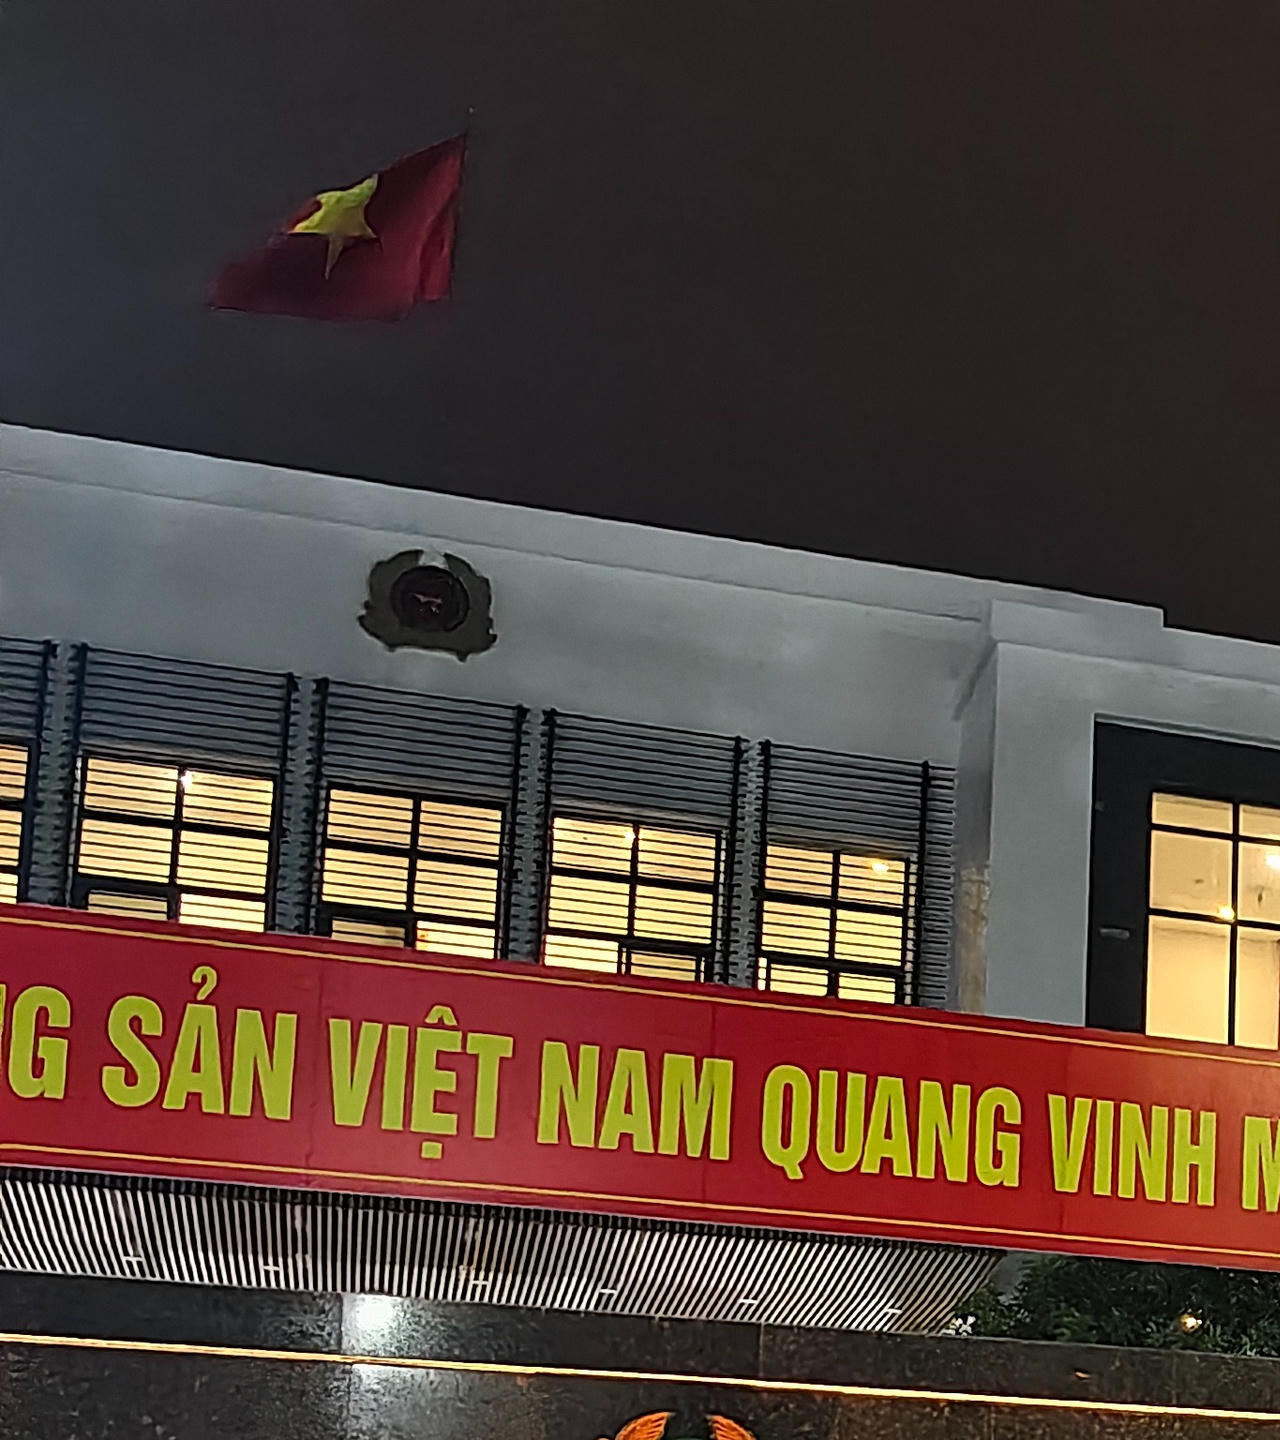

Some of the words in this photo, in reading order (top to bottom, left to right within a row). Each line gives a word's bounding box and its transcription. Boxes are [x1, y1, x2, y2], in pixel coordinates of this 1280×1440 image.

[0, 983, 71, 1100] G
[102, 966, 297, 1121] SẢN
[329, 1006, 513, 1160] VIỆT
[536, 1041, 735, 1161] NAM
[760, 1064, 1022, 1188] QUANG
[1048, 1094, 1218, 1207] VINH
